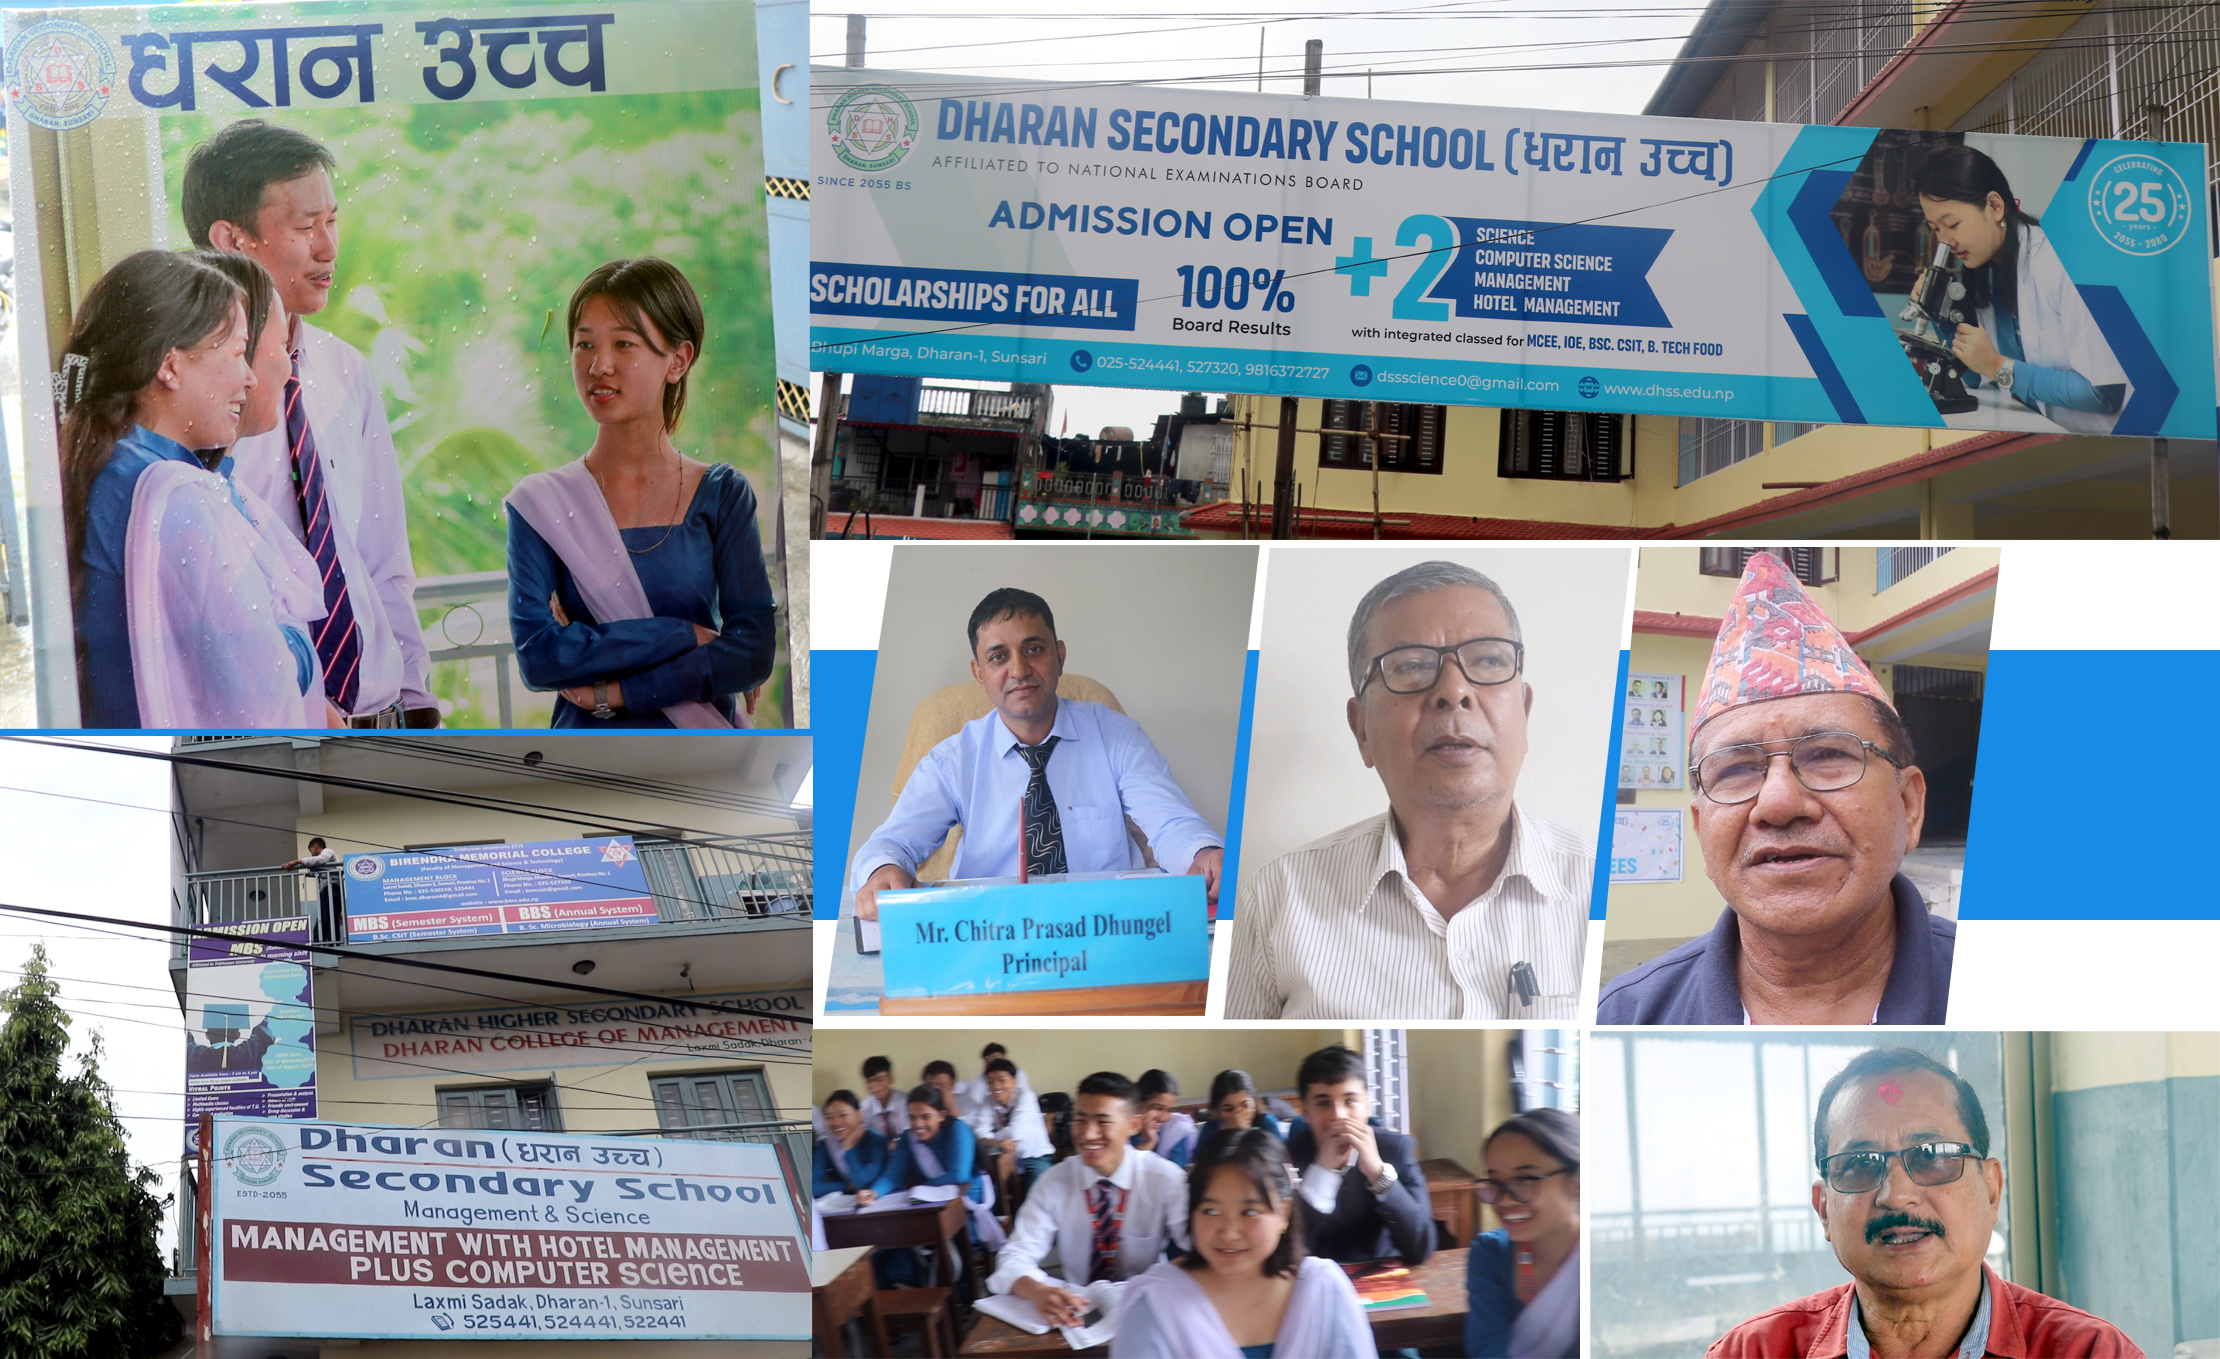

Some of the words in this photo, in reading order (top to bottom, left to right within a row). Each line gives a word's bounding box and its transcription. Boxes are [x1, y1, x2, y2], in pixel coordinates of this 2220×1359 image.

[6, 34, 28, 74] DHARAN
[28, 22, 88, 36] SECONDARY
[87, 32, 113, 71] SCHOOL
[120, 24, 383, 111] धरान
[415, 13, 615, 101] उच्च
[63, 109, 95, 127] SUNSARI
[904, 103, 916, 126] SCHOOL
[937, 99, 1098, 149] DHARAN
[1107, 108, 1339, 162] SECONDARY
[1345, 121, 1495, 171] SCHOOL
[869, 157, 896, 169] SUNSARI
[1504, 127, 1627, 176] (धरान
[1639, 138, 1733, 187] उच्च)
[2113, 161, 2164, 176] CELEBRATING
[817, 176, 855, 187] SINCE
[859, 178, 891, 189] 2055
[896, 181, 912, 191] BS
[931, 155, 1028, 172] AFFILIATED
[1037, 161, 1060, 174] TO
[1068, 163, 1157, 180] NATIONAL
[1165, 168, 1297, 188] EXAMINATIONS
[1305, 176, 1364, 191] BOARD
[2114, 181, 2166, 223] 25
[988, 200, 1212, 240] ADMISSION
[1223, 212, 1333, 246] OPEN
[2128, 223, 2151, 231] years
[1476, 226, 1535, 246] SCIENCE
[2113, 231, 2136, 248] 2055
[2145, 233, 2168, 248] 2080
[1334, 213, 1454, 322] +2
[1475, 249, 1551, 269] COMPUTER
[1553, 253, 1613, 272] SCIENCE
[1176, 264, 1296, 313] 100%
[1474, 271, 1572, 292] MANAGEMENT
[810, 273, 1010, 312] SCHOLARSHIPS
[1014, 284, 1066, 315] FOR
[1070, 288, 1118, 318] ALL
[1473, 294, 1517, 312] HOTEL
[1523, 297, 1621, 318] MANAGEMENT
[1172, 317, 1223, 333] Board
[1228, 320, 1292, 336] Results
[811, 341, 858, 357] Bhupi
[862, 344, 913, 361] Marga,
[917, 346, 988, 364] Dharan-1,
[991, 350, 1048, 365] Sunsari
[1351, 327, 1381, 339] with
[1384, 328, 1452, 343] integrated
[1455, 333, 1503, 346] classed
[1506, 335, 1525, 347] for
[1527, 334, 1561, 350] MCEE,
[1563, 335, 1586, 351] IOE,
[1589, 337, 1615, 351] BSC.
[1617, 338, 1645, 354] CSIT,
[1647, 340, 1659, 354] B.
[1661, 340, 1691, 355] TECH
[1693, 342, 1724, 357] FOOD
[1096, 356, 1183, 374] 025-524441,
[1186, 360, 1242, 377] 527320,
[1245, 363, 1330, 380] 9816372727
[1377, 370, 1560, 392] dssscience0@gmail.com
[1604, 384, 1734, 402] www.dhss.edu.np
[390, 854, 457, 867] BIRENDRA
[459, 848, 528, 862] MEMORIAL
[532, 846, 592, 858] COLLEGE
[382, 875, 434, 884] MANAGEMENT
[353, 916, 388, 931] MBS
[392, 917, 447, 929] (Semester
[450, 913, 493, 924] System)
[518, 906, 552, 920] BBS
[554, 907, 597, 919] (Annual
[600, 904, 643, 915] System)
[540, 921, 589, 930] Microbiology
[590, 919, 617, 927] (Annual
[619, 917, 650, 926] System)
[272, 919, 308, 932] OPEN
[409, 930, 447, 939] (Semester
[448, 927, 478, 935] System)
[915, 921, 949, 945] Mr.
[955, 917, 1016, 943] Chitra
[1022, 915, 1087, 940] Prasad
[1093, 911, 1172, 941] Dhungel
[229, 942, 264, 956] MBS
[1002, 950, 1088, 978] Principal
[371, 1016, 469, 1037] DHARAN
[478, 1011, 559, 1030] HIGHER
[567, 1003, 698, 1025] SECONDARY
[708, 995, 805, 1016] SCHOOL
[383, 1037, 483, 1058] DHARAN
[490, 1031, 590, 1052] COLLEGE
[598, 1028, 628, 1044] OF
[638, 1018, 800, 1041] MANAGEMENT
[687, 1042, 720, 1052] Laxmi
[300, 1128, 496, 1159] Dharan
[237, 1190, 288, 1199] ESTD-2055
[302, 1163, 595, 1203] Secondary
[615, 1178, 777, 1205] School
[403, 1200, 540, 1226] Management
[545, 1206, 560, 1223] &
[565, 1206, 651, 1225] Science
[231, 1224, 447, 1256] MANAGEMENT
[455, 1231, 532, 1258] WITH
[538, 1234, 622, 1259] HOTEL
[623, 1236, 792, 1262] MANAGEMENT
[350, 1256, 434, 1282] PLUS
[445, 1259, 612, 1285] COMPUTER
[413, 1293, 467, 1309] Laxmi
[471, 1293, 534, 1311] Sadak,
[536, 1294, 617, 1311] Dharan-1,
[620, 1295, 685, 1311] Sunsari
